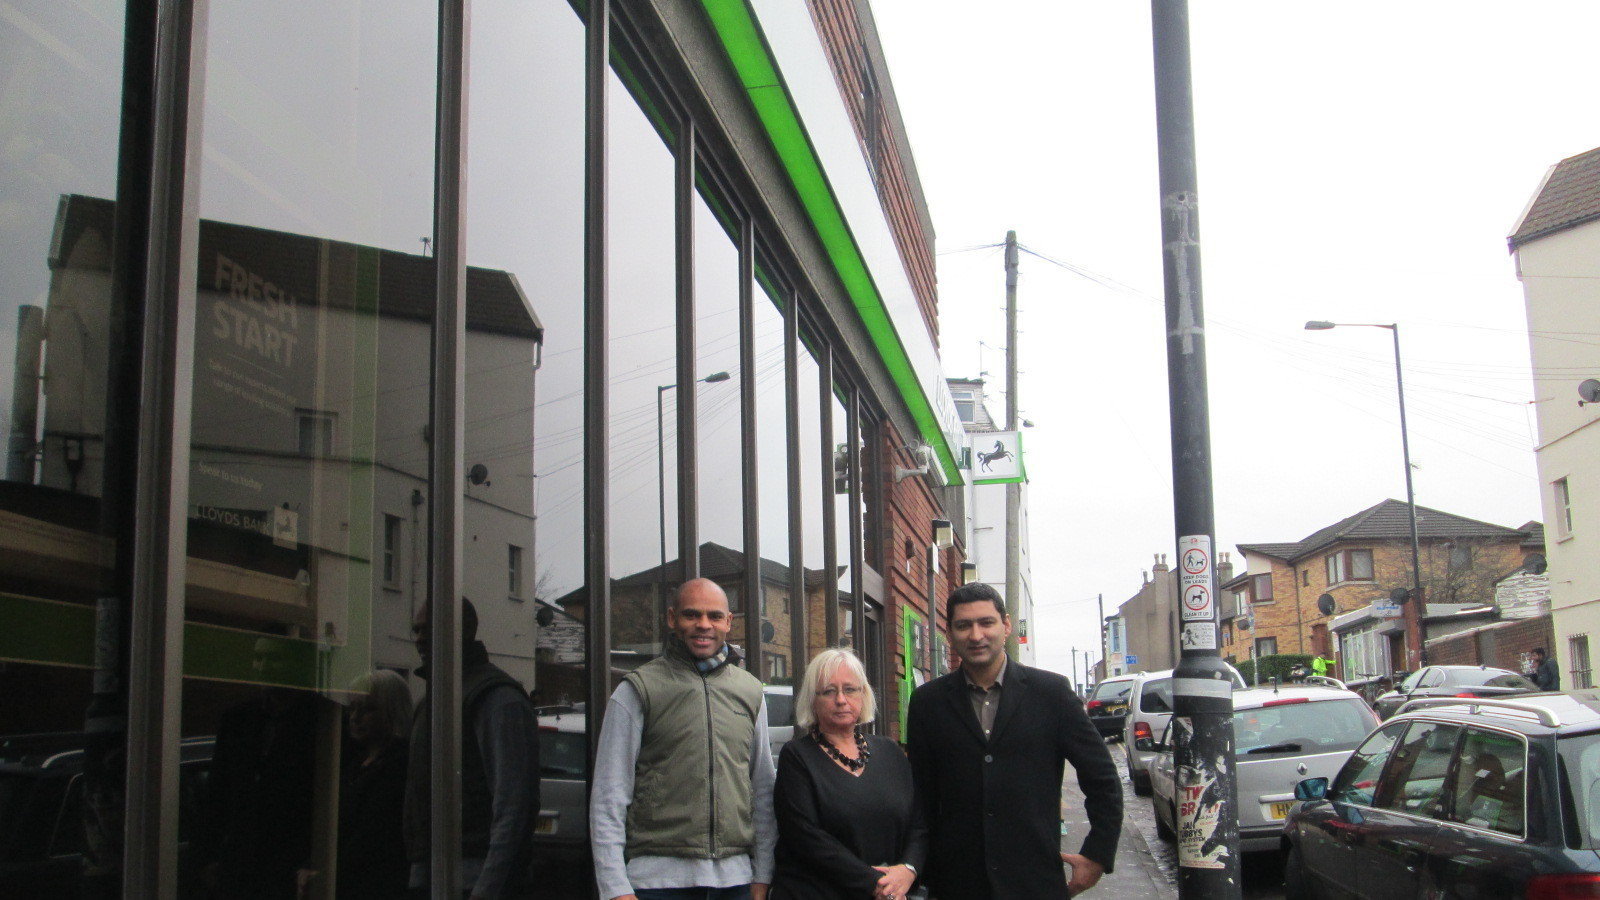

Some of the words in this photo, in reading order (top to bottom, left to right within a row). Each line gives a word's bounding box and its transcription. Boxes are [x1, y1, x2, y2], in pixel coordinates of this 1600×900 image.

[215, 252, 297, 329] FRESH
[213, 301, 297, 367] START
[194, 503, 240, 526] LLOYDS
[243, 516, 272, 536] BANK
